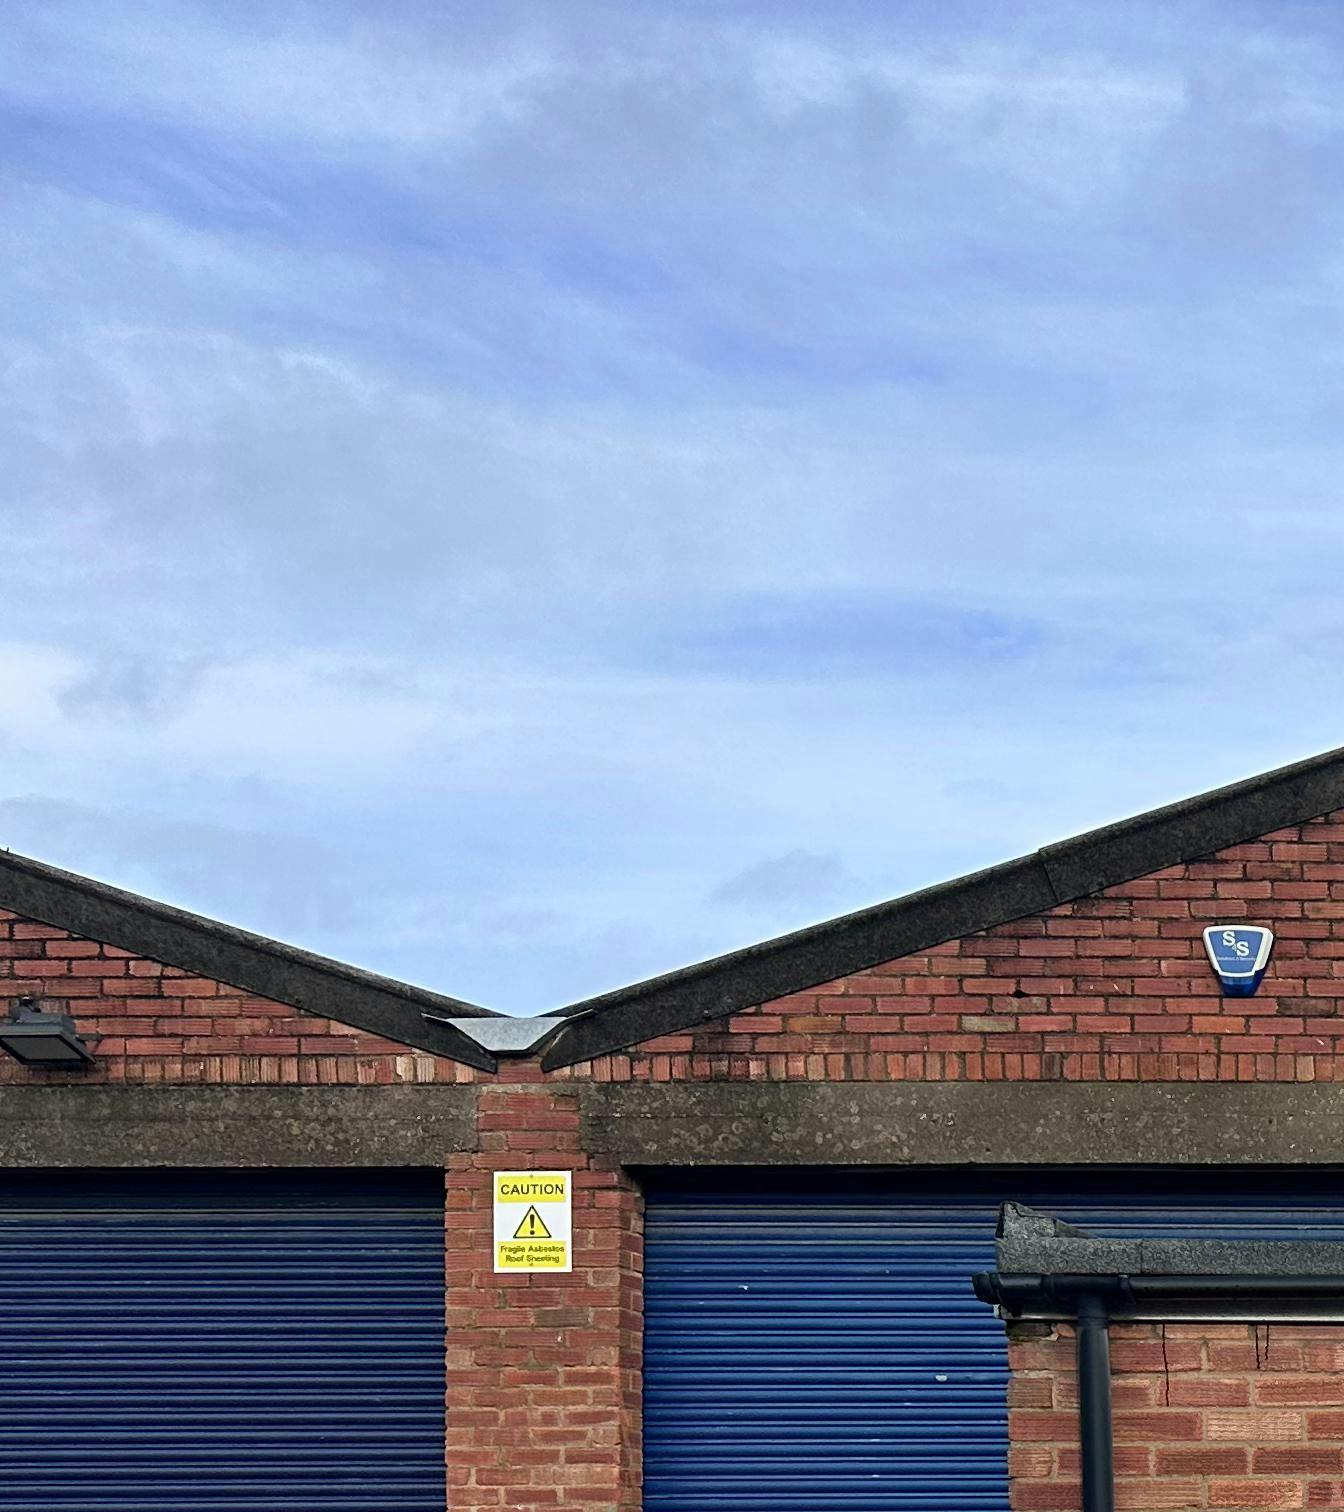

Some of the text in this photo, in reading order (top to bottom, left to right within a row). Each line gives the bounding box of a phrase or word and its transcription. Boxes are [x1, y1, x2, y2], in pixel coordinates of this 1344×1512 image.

[500, 1184, 564, 1195] CAUTION
[500, 1245, 525, 1254] Fragile
[505, 1255, 560, 1263] Roof Sheeting
